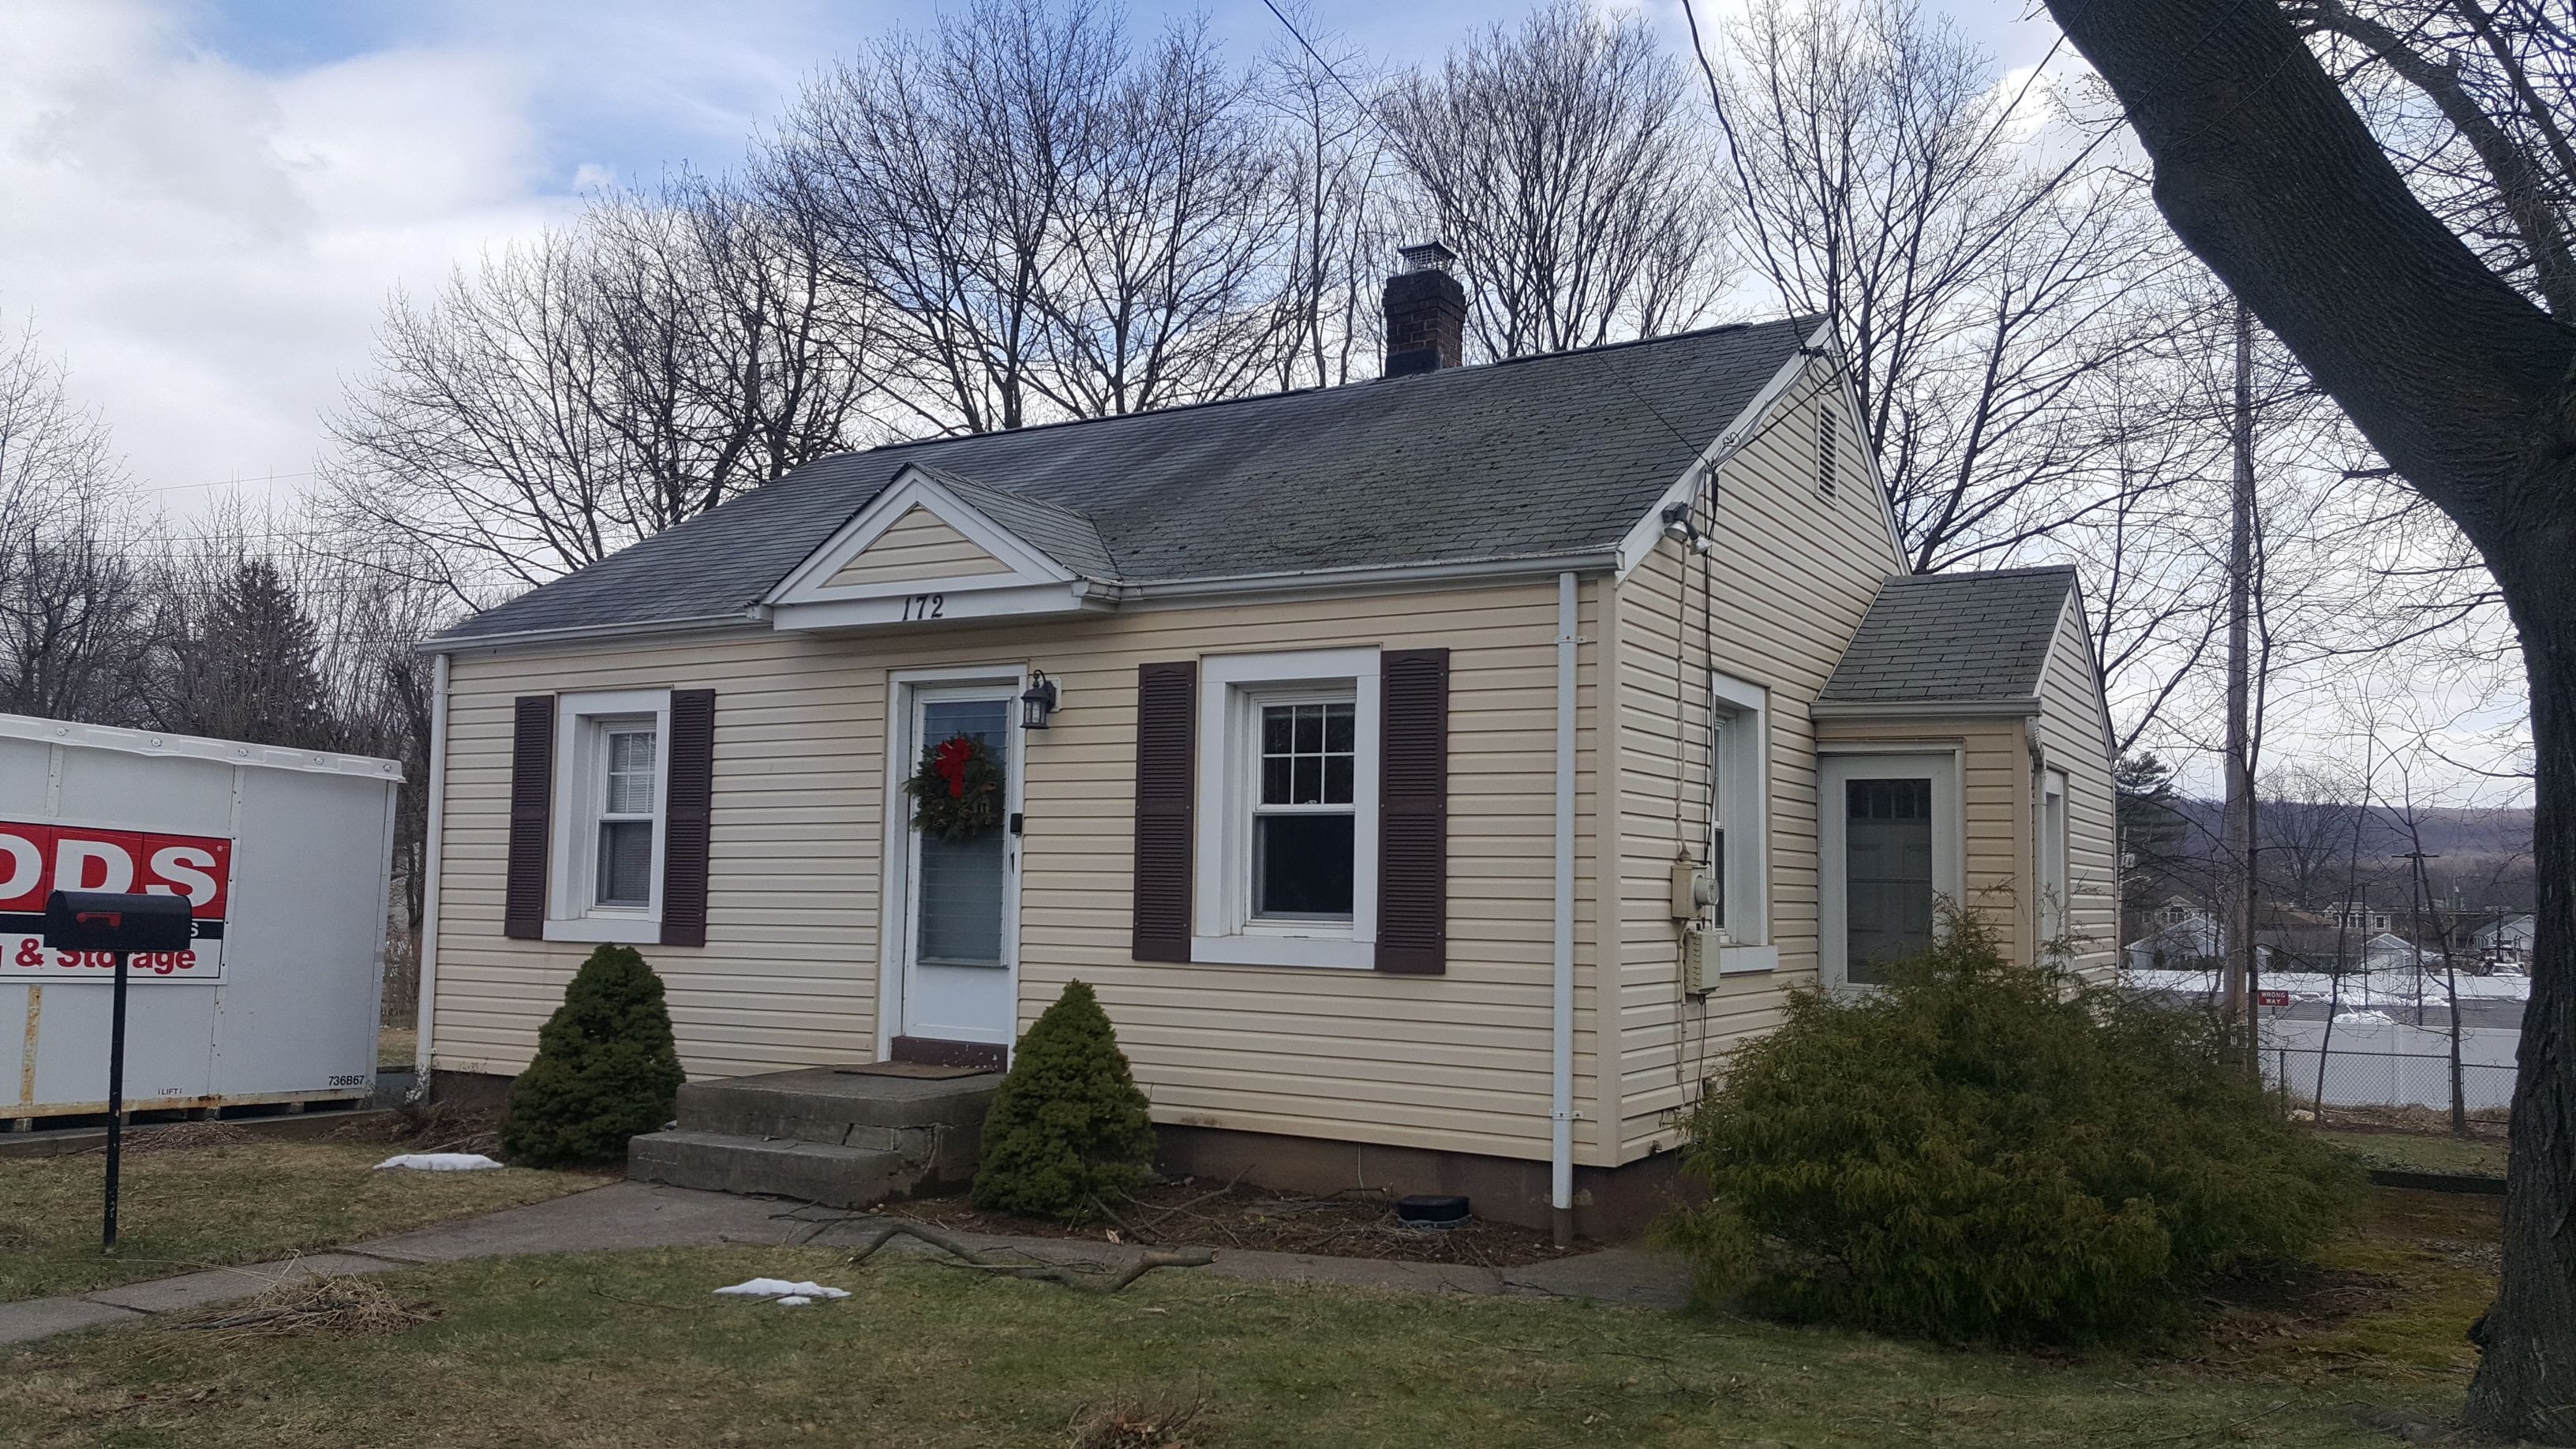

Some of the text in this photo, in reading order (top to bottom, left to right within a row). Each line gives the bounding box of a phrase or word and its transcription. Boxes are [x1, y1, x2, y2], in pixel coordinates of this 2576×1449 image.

[902, 594, 943, 621] 172
[15, 938, 45, 968] &
[56, 949, 197, 975] Stoage
[328, 1075, 365, 1086] 736B67
